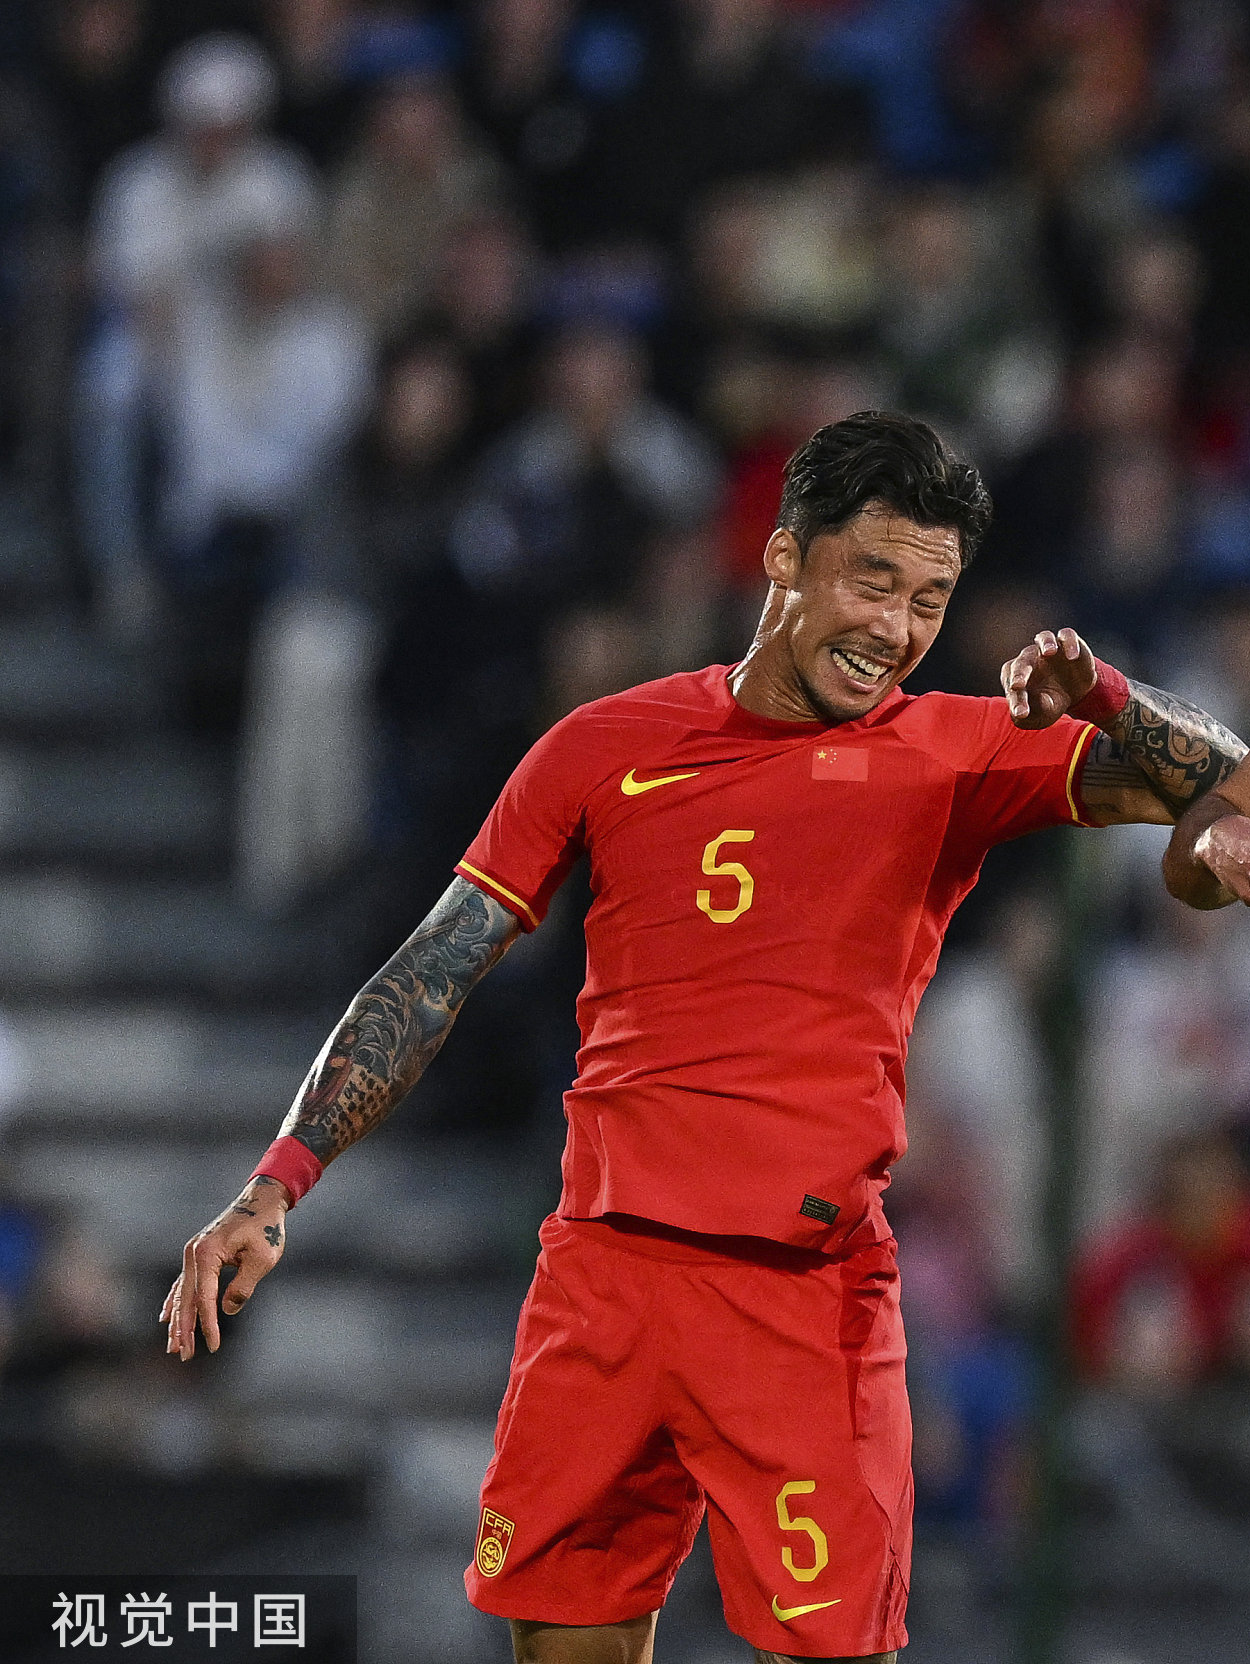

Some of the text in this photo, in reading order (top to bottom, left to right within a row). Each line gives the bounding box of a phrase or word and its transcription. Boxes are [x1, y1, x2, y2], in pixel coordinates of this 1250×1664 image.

[696, 829, 755, 924] 5
[485, 1512, 512, 1537] CFA
[775, 1480, 829, 1582] 5
